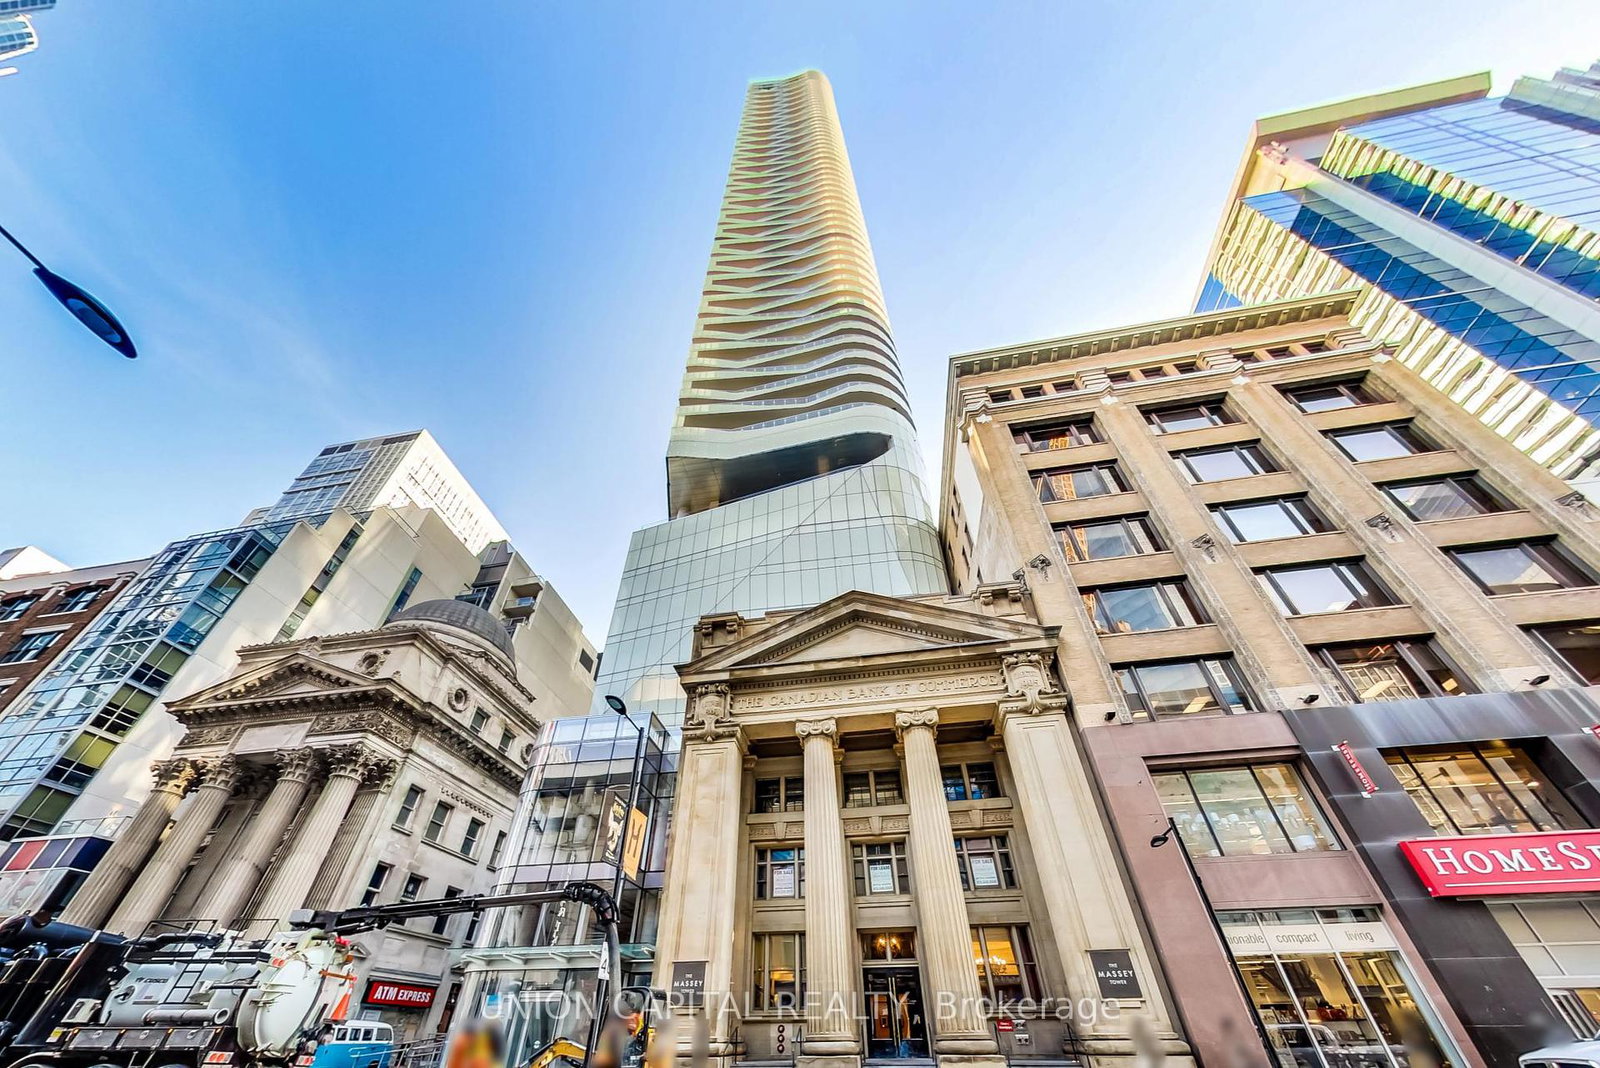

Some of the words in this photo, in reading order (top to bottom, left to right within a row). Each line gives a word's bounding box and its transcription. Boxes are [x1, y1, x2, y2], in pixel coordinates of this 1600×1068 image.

[738, 697, 763, 709] THE
[769, 691, 842, 706] CANADIAN
[847, 685, 891, 700] BANK
[896, 683, 912, 695] OF
[919, 675, 998, 692] COMMERCE
[1275, 933, 1320, 945] compact
[1345, 931, 1374, 943] living
[1098, 970, 1133, 978] MASSEY
[373, 985, 398, 1001] ATM
[397, 989, 431, 1003] EXPRESS
